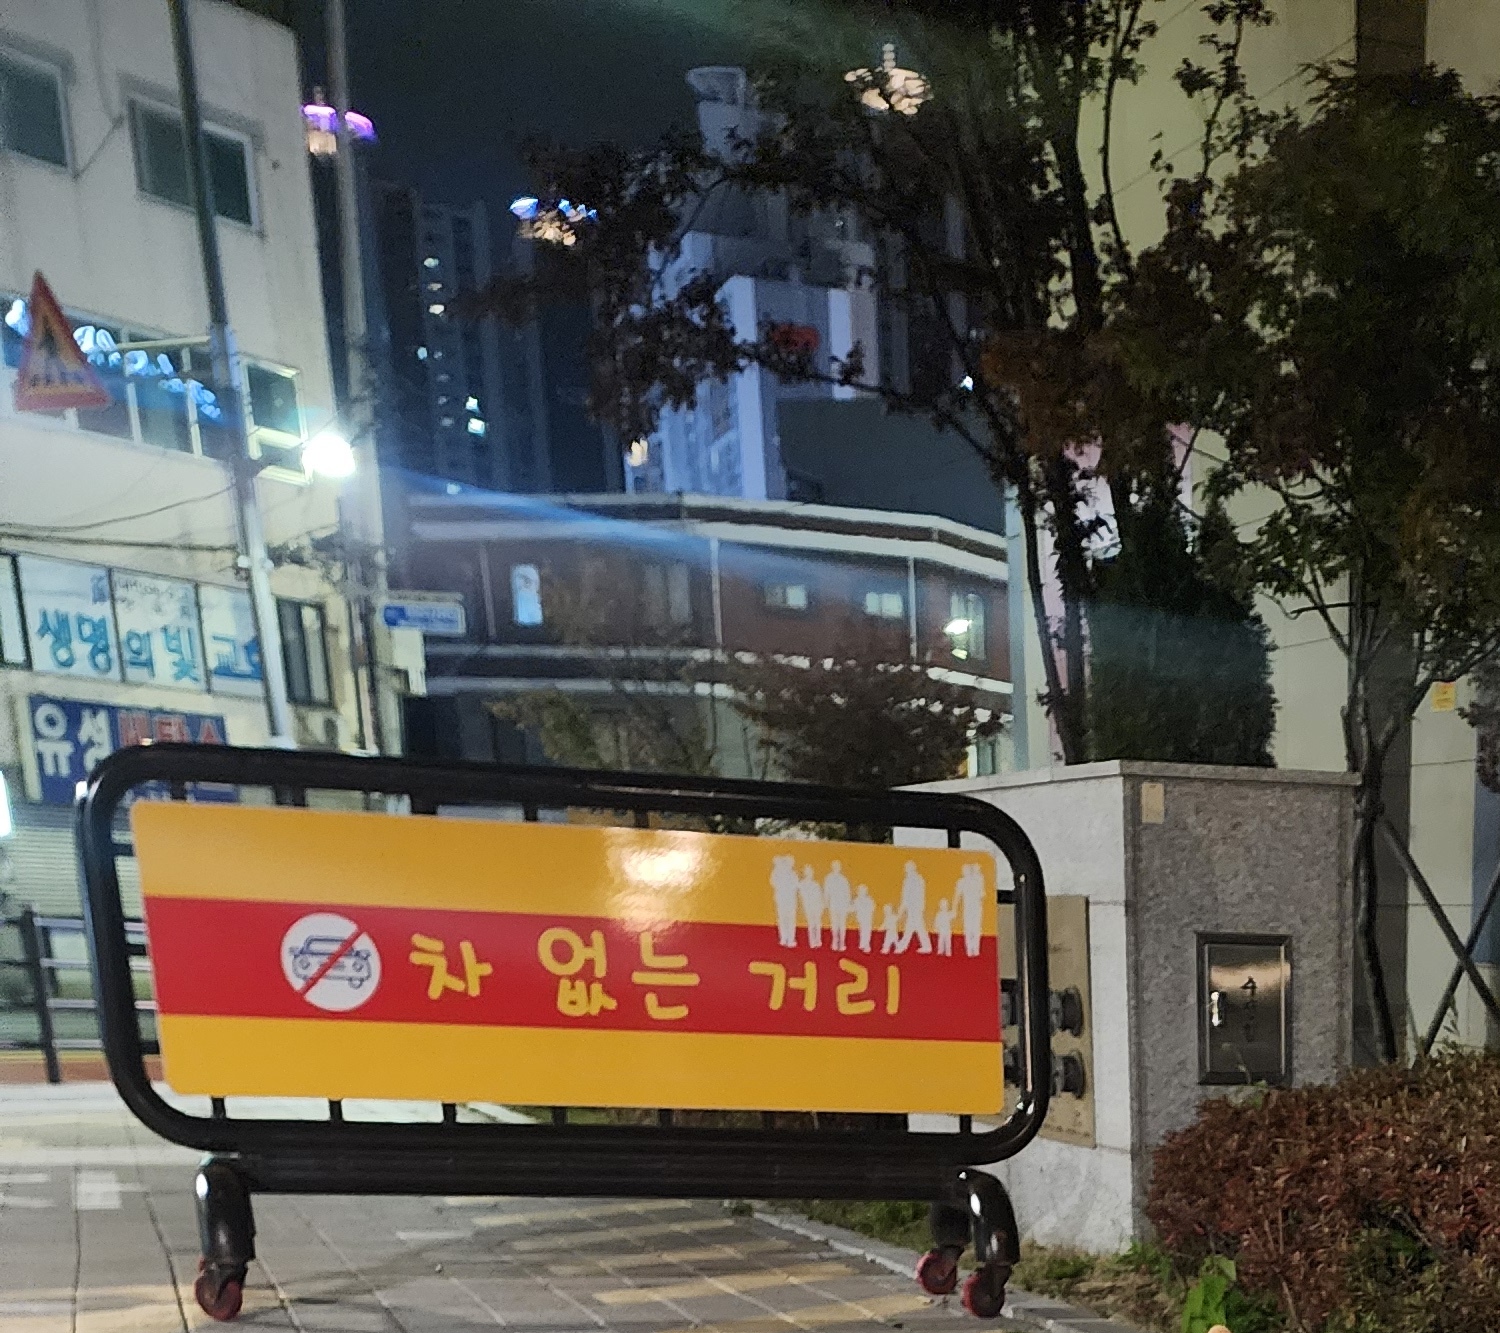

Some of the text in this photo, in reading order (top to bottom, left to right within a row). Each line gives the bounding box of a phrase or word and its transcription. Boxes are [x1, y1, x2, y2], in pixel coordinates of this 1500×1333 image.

[409, 927, 900, 1020] 차 없는 거리
